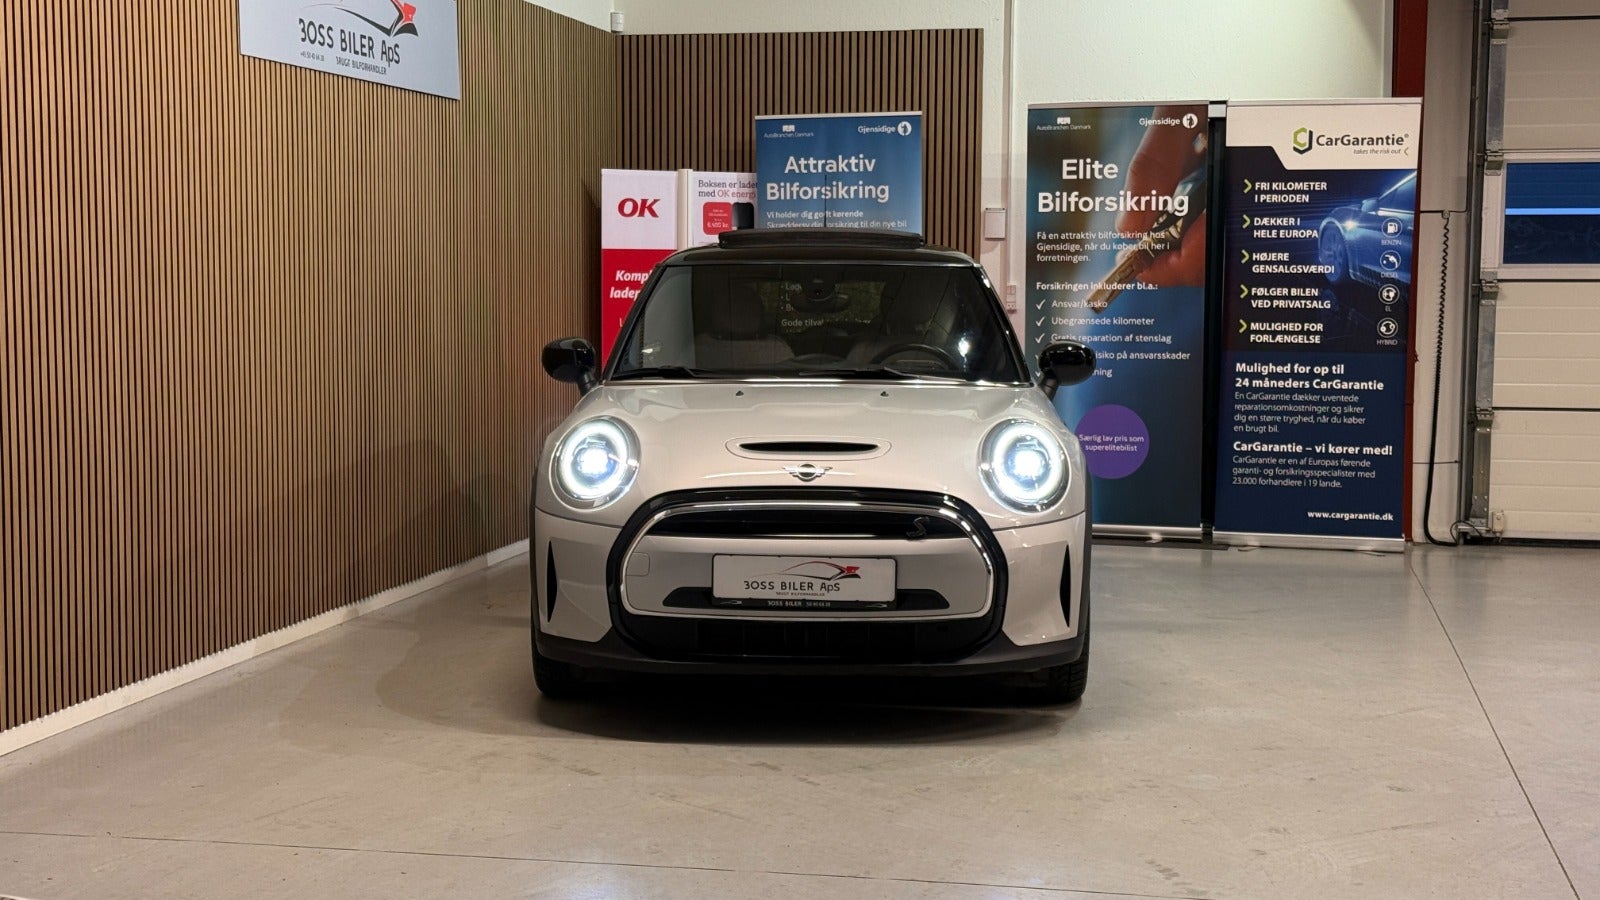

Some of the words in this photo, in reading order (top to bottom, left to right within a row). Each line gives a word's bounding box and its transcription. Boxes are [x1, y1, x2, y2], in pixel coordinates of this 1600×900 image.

[340, 29, 375, 58] BILER
[380, 40, 400, 67] ApS
[352, 60, 386, 74] BILFORHANDLER
[1139, 118, 1181, 129] Gjensidige
[858, 125, 896, 134] Gjensidige
[784, 154, 876, 173] Attraktiv
[1062, 158, 1118, 180] Elite
[698, 180, 726, 188] Boksen
[1255, 182, 1269, 190] FRI
[1272, 182, 1327, 191] KILOMETER
[767, 181, 888, 203] Bilforsikring
[1255, 194, 1258, 202] I
[1260, 194, 1309, 202] PERIODEN
[618, 198, 660, 218] OK
[1038, 190, 1189, 217] Bilforsikring
[801, 211, 813, 219] dig
[1254, 217, 1295, 226] DÆKKER
[1297, 218, 1300, 226] I
[1037, 231, 1047, 239] Få
[1061, 232, 1096, 240] attraktiv
[1098, 232, 1148, 242] bilforsikring
[1254, 230, 1277, 238] HELE
[1280, 230, 1318, 238] EUROPA
[1037, 243, 1082, 252] Gjensidige,
[1085, 242, 1098, 250] når
[1100, 242, 1111, 250] du
[1037, 254, 1091, 263] forretningen.
[1253, 252, 1289, 261] HØJERE
[1252, 265, 1334, 274] GENSALGSVÆRDI
[616, 270, 653, 284] Komp
[1036, 282, 1088, 292] Forsikringen
[1091, 282, 1135, 290] inkluderer
[1252, 287, 1288, 296] FØLGER
[1291, 288, 1318, 296] BILEN
[1052, 300, 1108, 309] Ansvar/kasko
[1251, 300, 1271, 308] VED
[1273, 300, 1331, 309] PRIVATSALG
[1052, 317, 1111, 327] Ubegrænsede
[1113, 317, 1154, 325] kilometer
[1251, 323, 1300, 331] MULIGHED
[1304, 323, 1323, 331] FOR
[1079, 334, 1122, 343] reparation
[1124, 334, 1133, 342] af
[1135, 334, 1172, 344] stenslag
[1250, 335, 1320, 343] FORLÆNGELSE
[1117, 351, 1127, 360] på
[1130, 352, 1190, 360] ansvarsskader
[1236, 363, 1290, 375] Mulighed
[1294, 364, 1310, 373] for
[1314, 366, 1328, 376] op
[1332, 364, 1344, 374] til
[1235, 378, 1249, 387] 24
[1252, 378, 1310, 388] måneders
[1313, 379, 1384, 390] CarGarantie
[1235, 392, 1244, 400] En
[1246, 393, 1290, 401] CarGarantie
[1292, 393, 1320, 401] dækker
[1322, 394, 1359, 402] uventede
[1235, 403, 1329, 413] reparationsomkostninger
[1331, 406, 1342, 414] og
[1344, 405, 1364, 413] sikrer
[1234, 414, 1246, 423] dig
[1260, 414, 1281, 422] større
[1283, 414, 1315, 424] tryghed,
[1317, 415, 1329, 423] når
[1331, 416, 1341, 424] du
[1343, 416, 1365, 424] køber
[1245, 424, 1266, 433] brugt
[1115, 435, 1127, 443] pris
[1233, 441, 1302, 452] CarGarantie
[1315, 444, 1325, 453] vi
[1328, 444, 1360, 454] kører
[1363, 445, 1392, 455] med!
[1233, 456, 1276, 464] CarGarantie
[1299, 457, 1307, 465] af
[1308, 458, 1338, 467] Europas
[1340, 458, 1370, 467] førende
[1232, 467, 1262, 476] garanti-
[1264, 468, 1273, 476] og
[1276, 467, 1355, 478] forsikringsspecialister
[1232, 477, 1257, 485] 23.000
[1259, 478, 1302, 486] forhandlere
[1308, 479, 1317, 487] 19
[1319, 479, 1342, 487] lande.
[1308, 510, 1393, 521] www.cargarantie.dk
[781, 582, 813, 590] BILER
[820, 583, 840, 593] ApS
